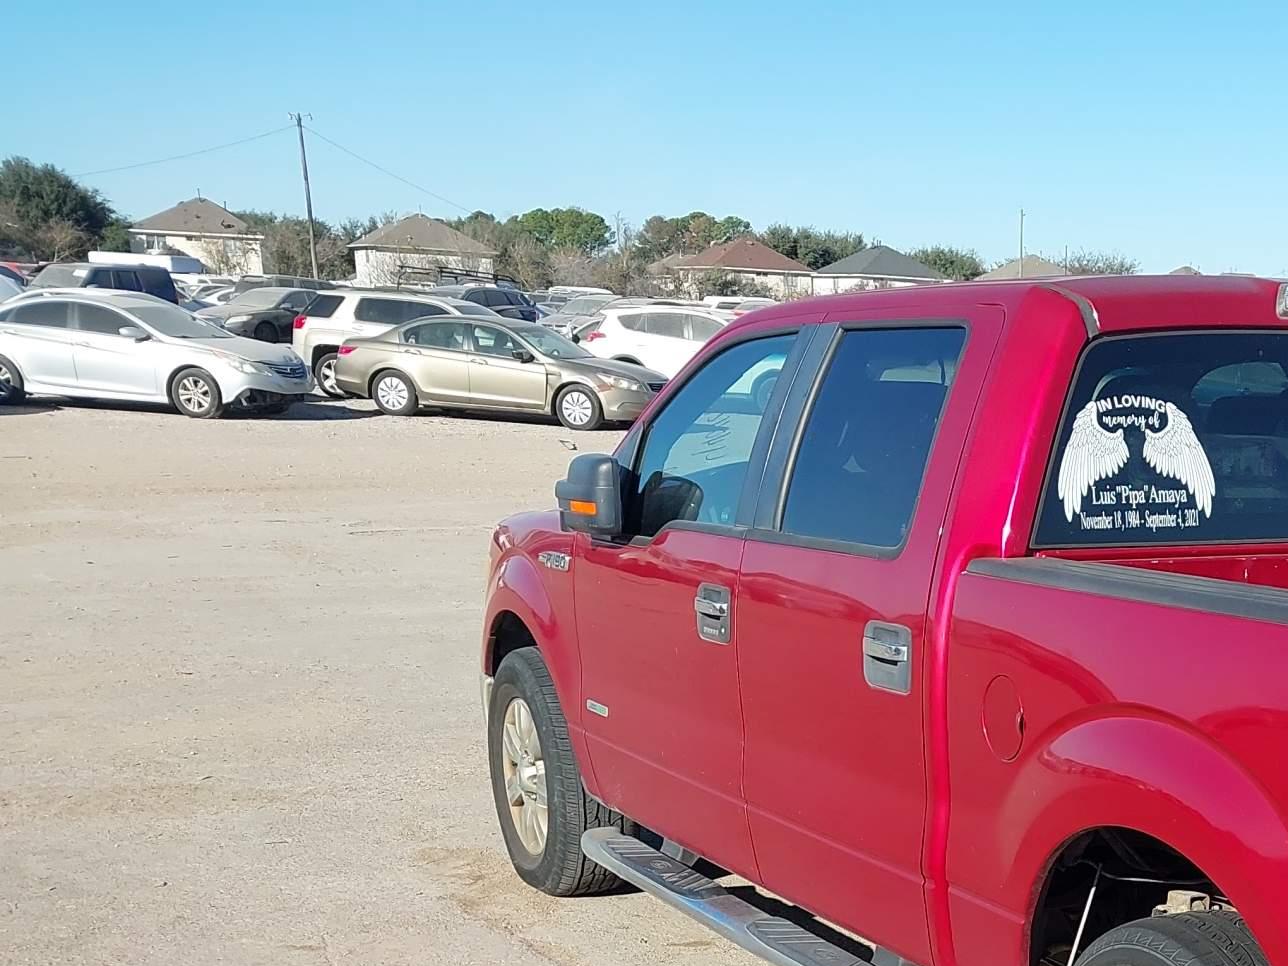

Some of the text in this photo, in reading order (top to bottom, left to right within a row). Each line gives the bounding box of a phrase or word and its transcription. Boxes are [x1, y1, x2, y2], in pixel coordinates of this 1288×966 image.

[1097, 395, 1166, 413] IN LOVING
[1103, 411, 1161, 432] memory of
[1091, 485, 1116, 505] Luis
[1149, 485, 1188, 508] Amaya
[1080, 511, 1113, 530] November
[1145, 508, 1177, 533] September
[1185, 508, 1199, 527] 2021
